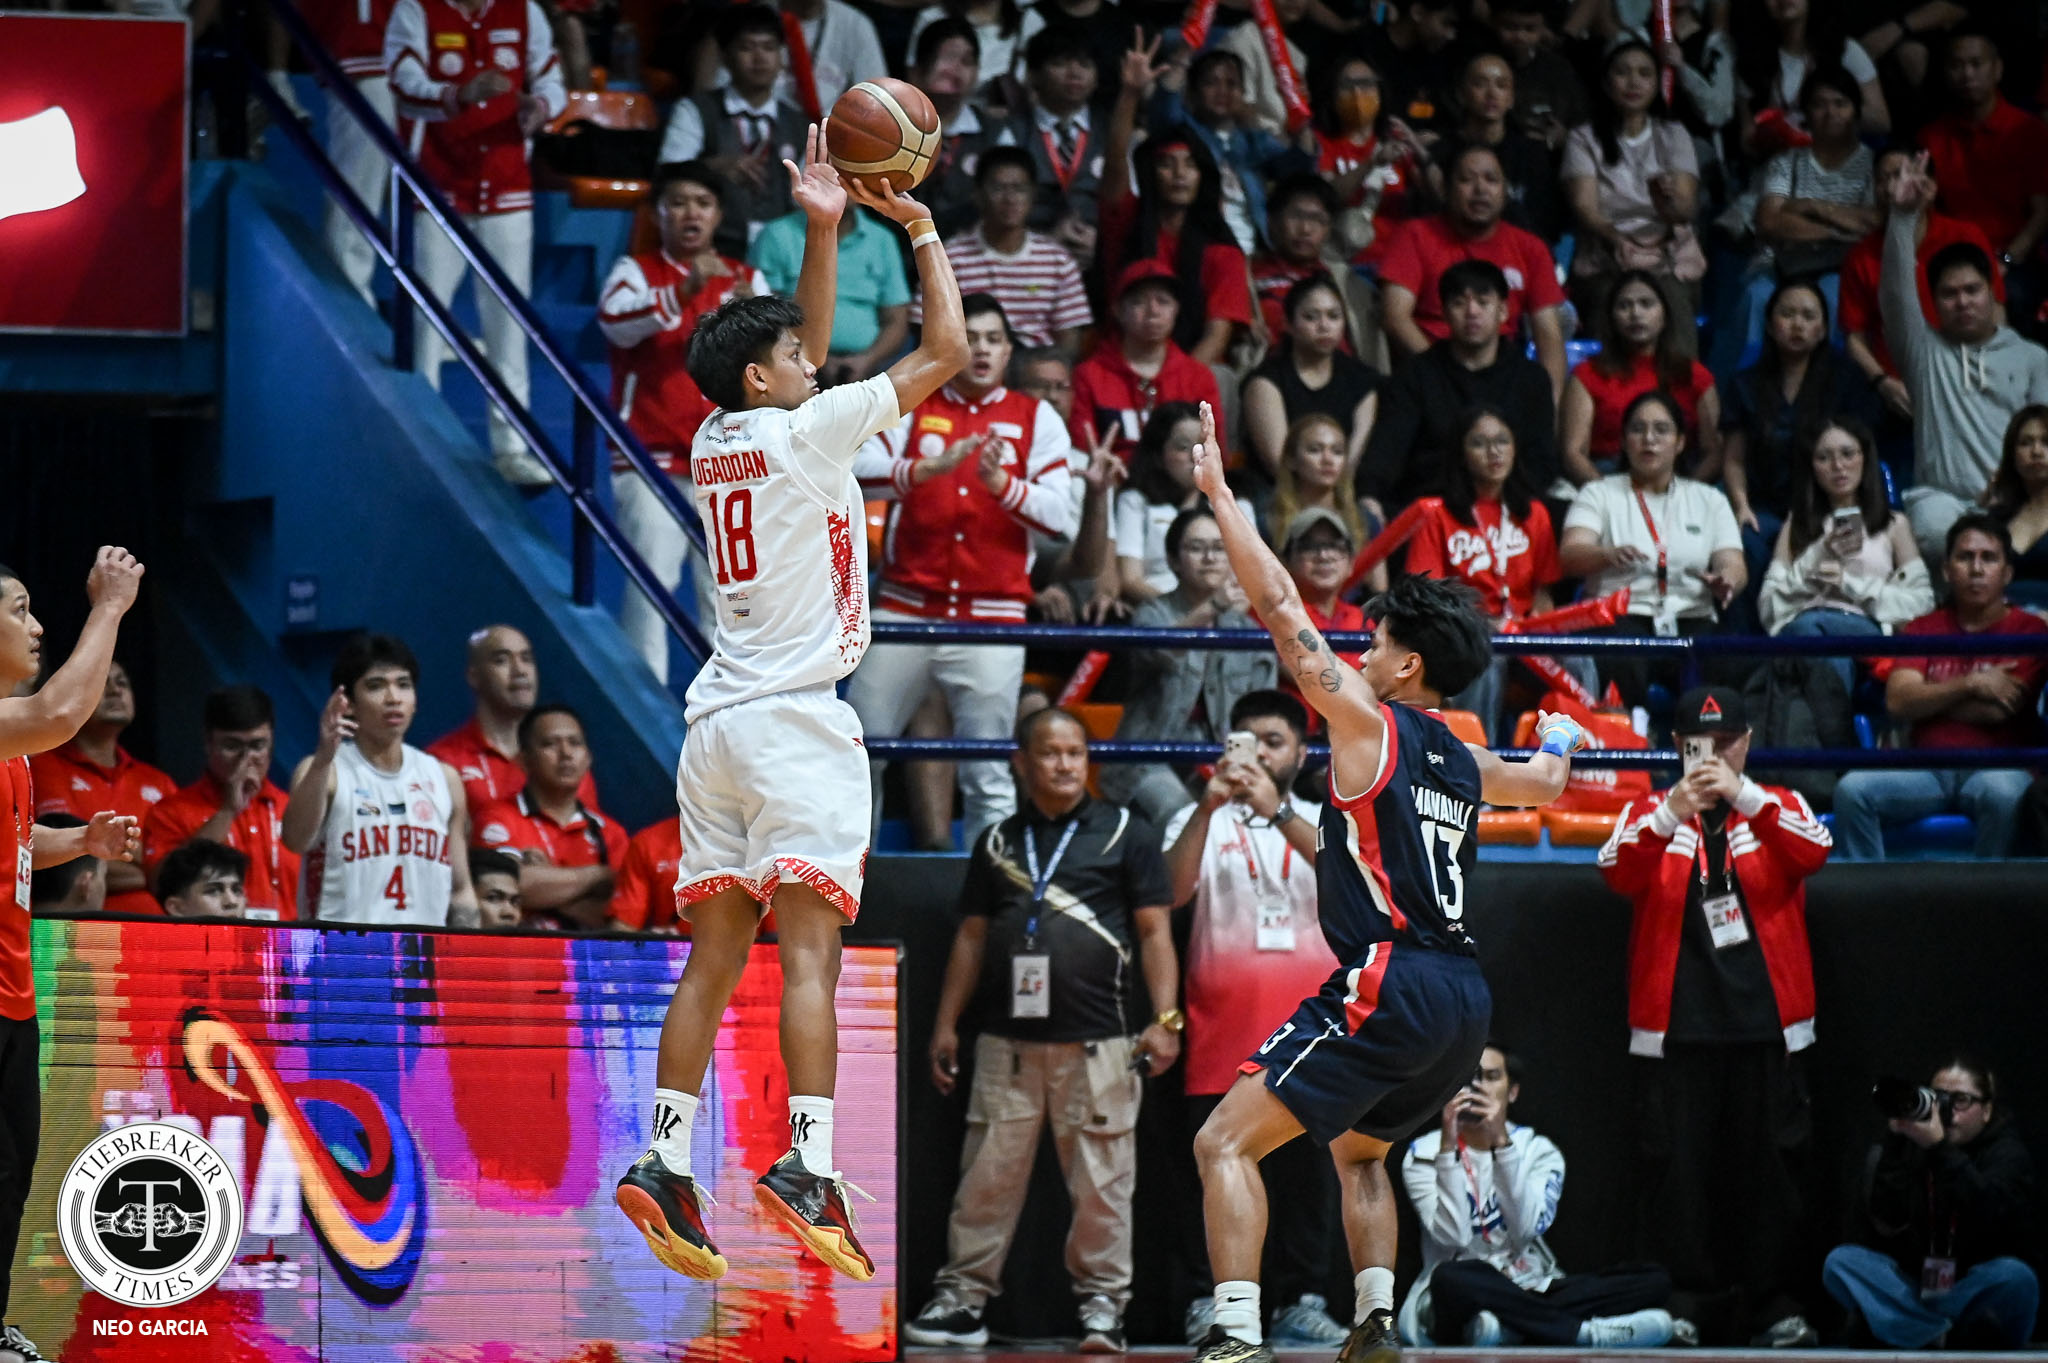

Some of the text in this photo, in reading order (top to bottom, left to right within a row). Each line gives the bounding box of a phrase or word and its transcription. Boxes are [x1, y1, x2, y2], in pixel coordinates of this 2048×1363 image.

[709, 488, 758, 585] 18
[342, 823, 453, 867] SAN BEDA
[1420, 820, 1467, 920] 13
[384, 864, 408, 910] 4
